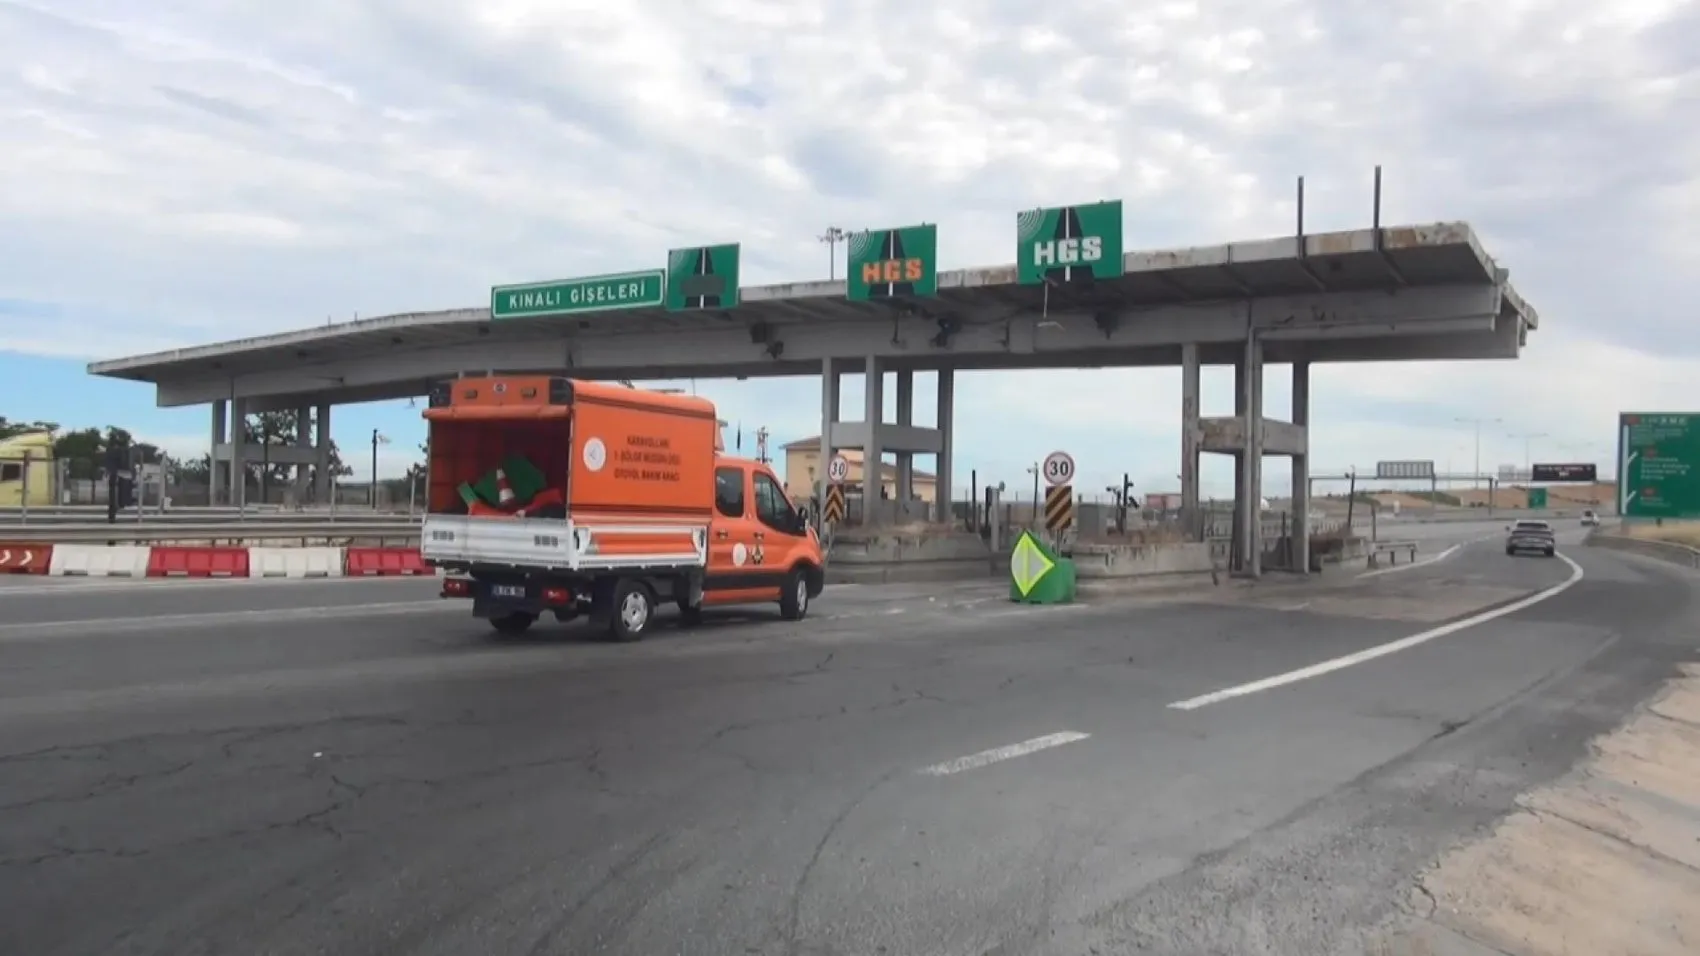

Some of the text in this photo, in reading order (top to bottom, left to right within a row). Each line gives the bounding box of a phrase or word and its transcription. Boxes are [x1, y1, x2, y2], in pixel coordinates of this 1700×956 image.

[1034, 235, 1102, 266] HGS
[862, 258, 922, 284] HGS
[509, 280, 645, 309] KINALI GİŞELERİ
[831, 461, 845, 476] 30
[1050, 460, 1069, 477] 30
